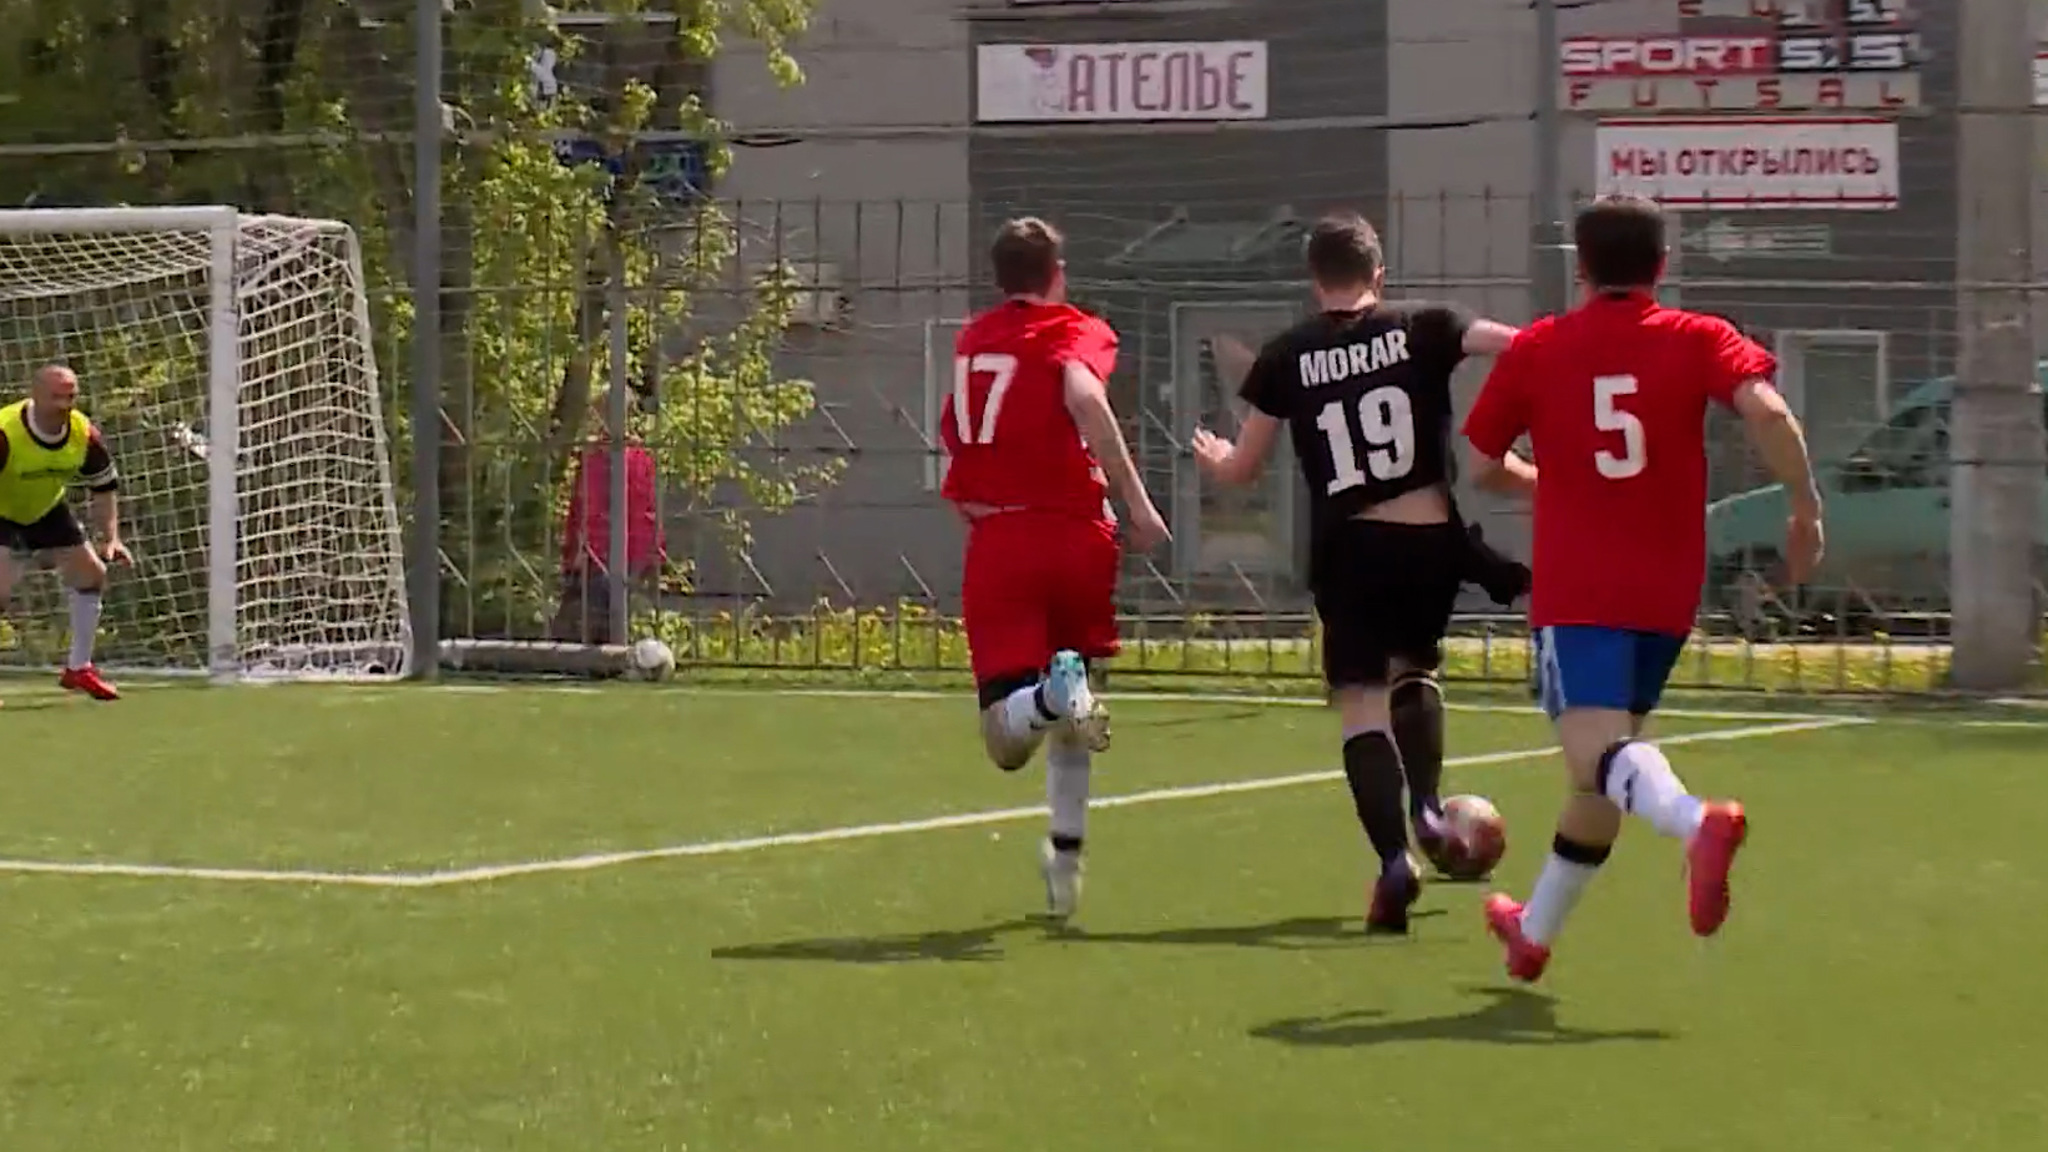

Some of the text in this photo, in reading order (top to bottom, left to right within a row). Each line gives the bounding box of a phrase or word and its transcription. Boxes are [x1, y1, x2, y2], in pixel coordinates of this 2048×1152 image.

[1067, 51, 1254, 112] АТЕЛЬЕ
[1562, 37, 1770, 71] SPORT
[1609, 147, 1880, 177] МЫ ОТКРЫЛИСЬ
[1299, 328, 1411, 388] MORAR
[953, 352, 1018, 444] 17
[1593, 374, 1647, 479] 5
[1316, 385, 1416, 497] 19
